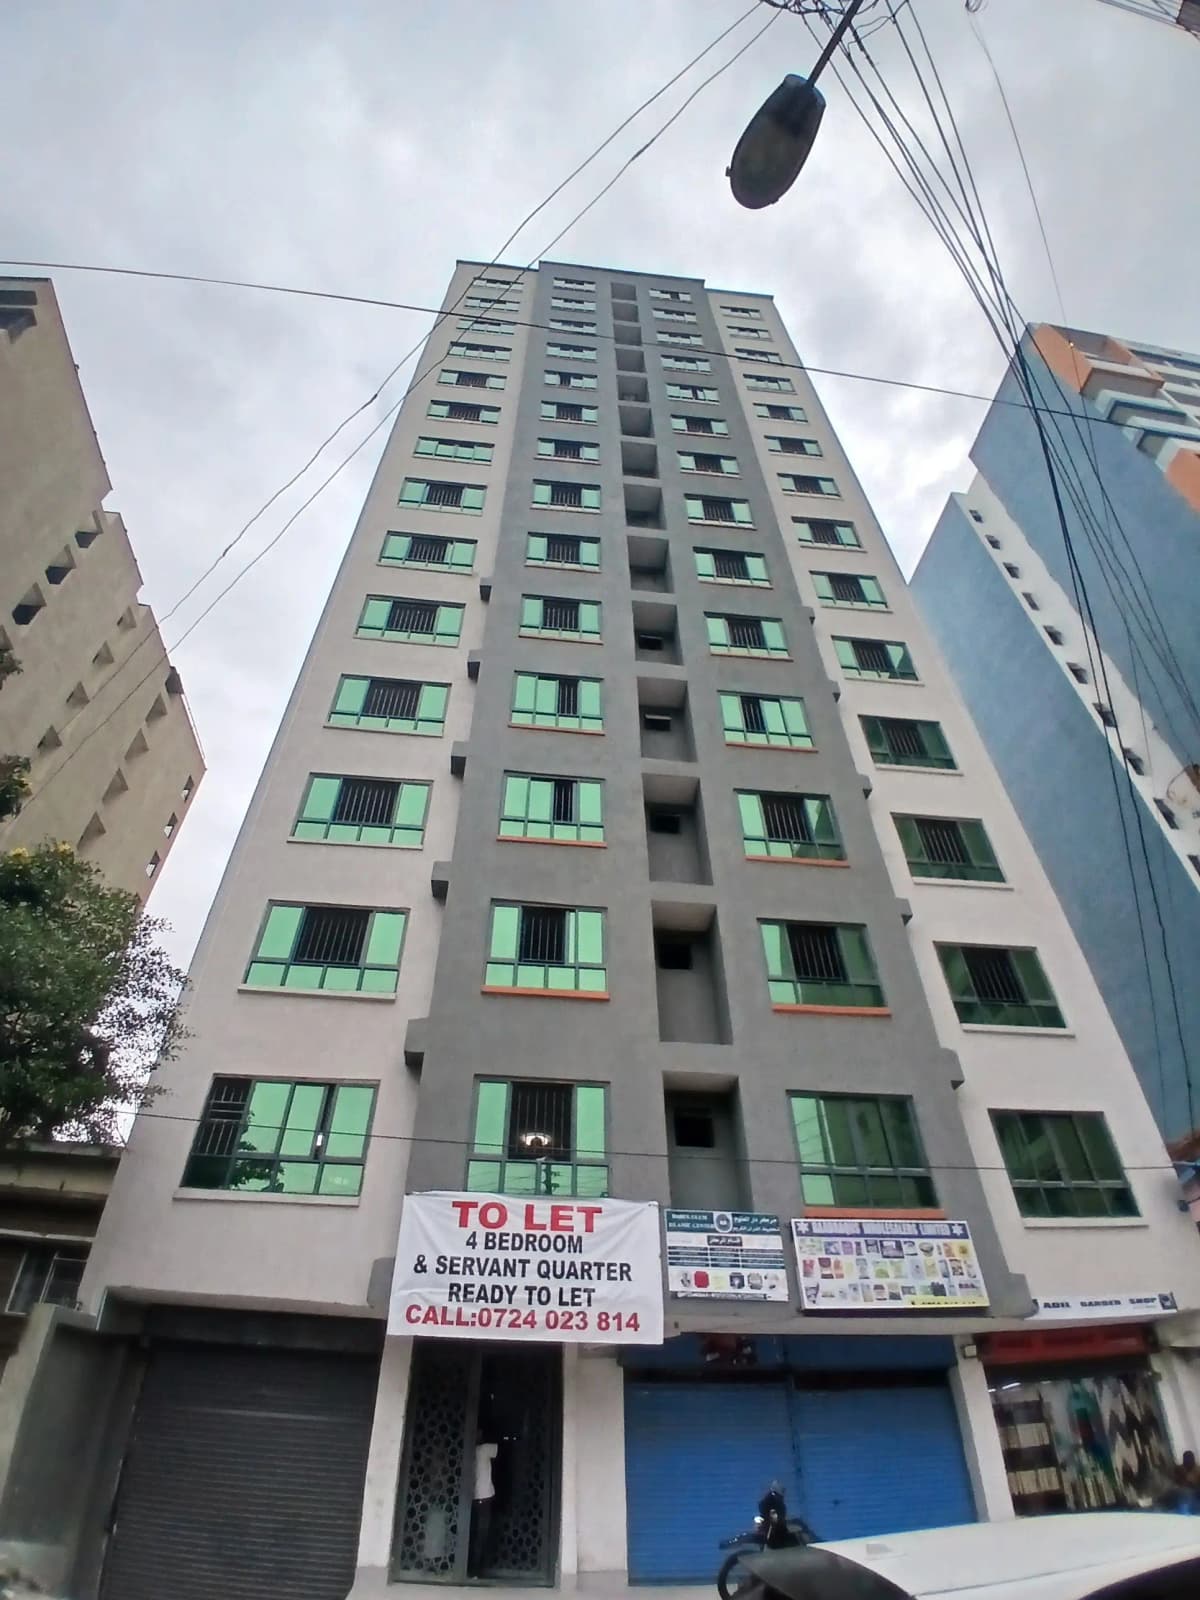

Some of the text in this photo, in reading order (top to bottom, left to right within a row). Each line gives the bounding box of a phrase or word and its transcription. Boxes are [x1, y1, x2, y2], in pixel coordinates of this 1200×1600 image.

[452, 1201, 603, 1233] TO LET
[466, 1231, 583, 1254] 4 BEDROOM
[413, 1254, 633, 1282] & SERVANT QUARTER
[448, 1283, 596, 1308] READY TO LET
[405, 1304, 640, 1332] CALL:0724 023 814
